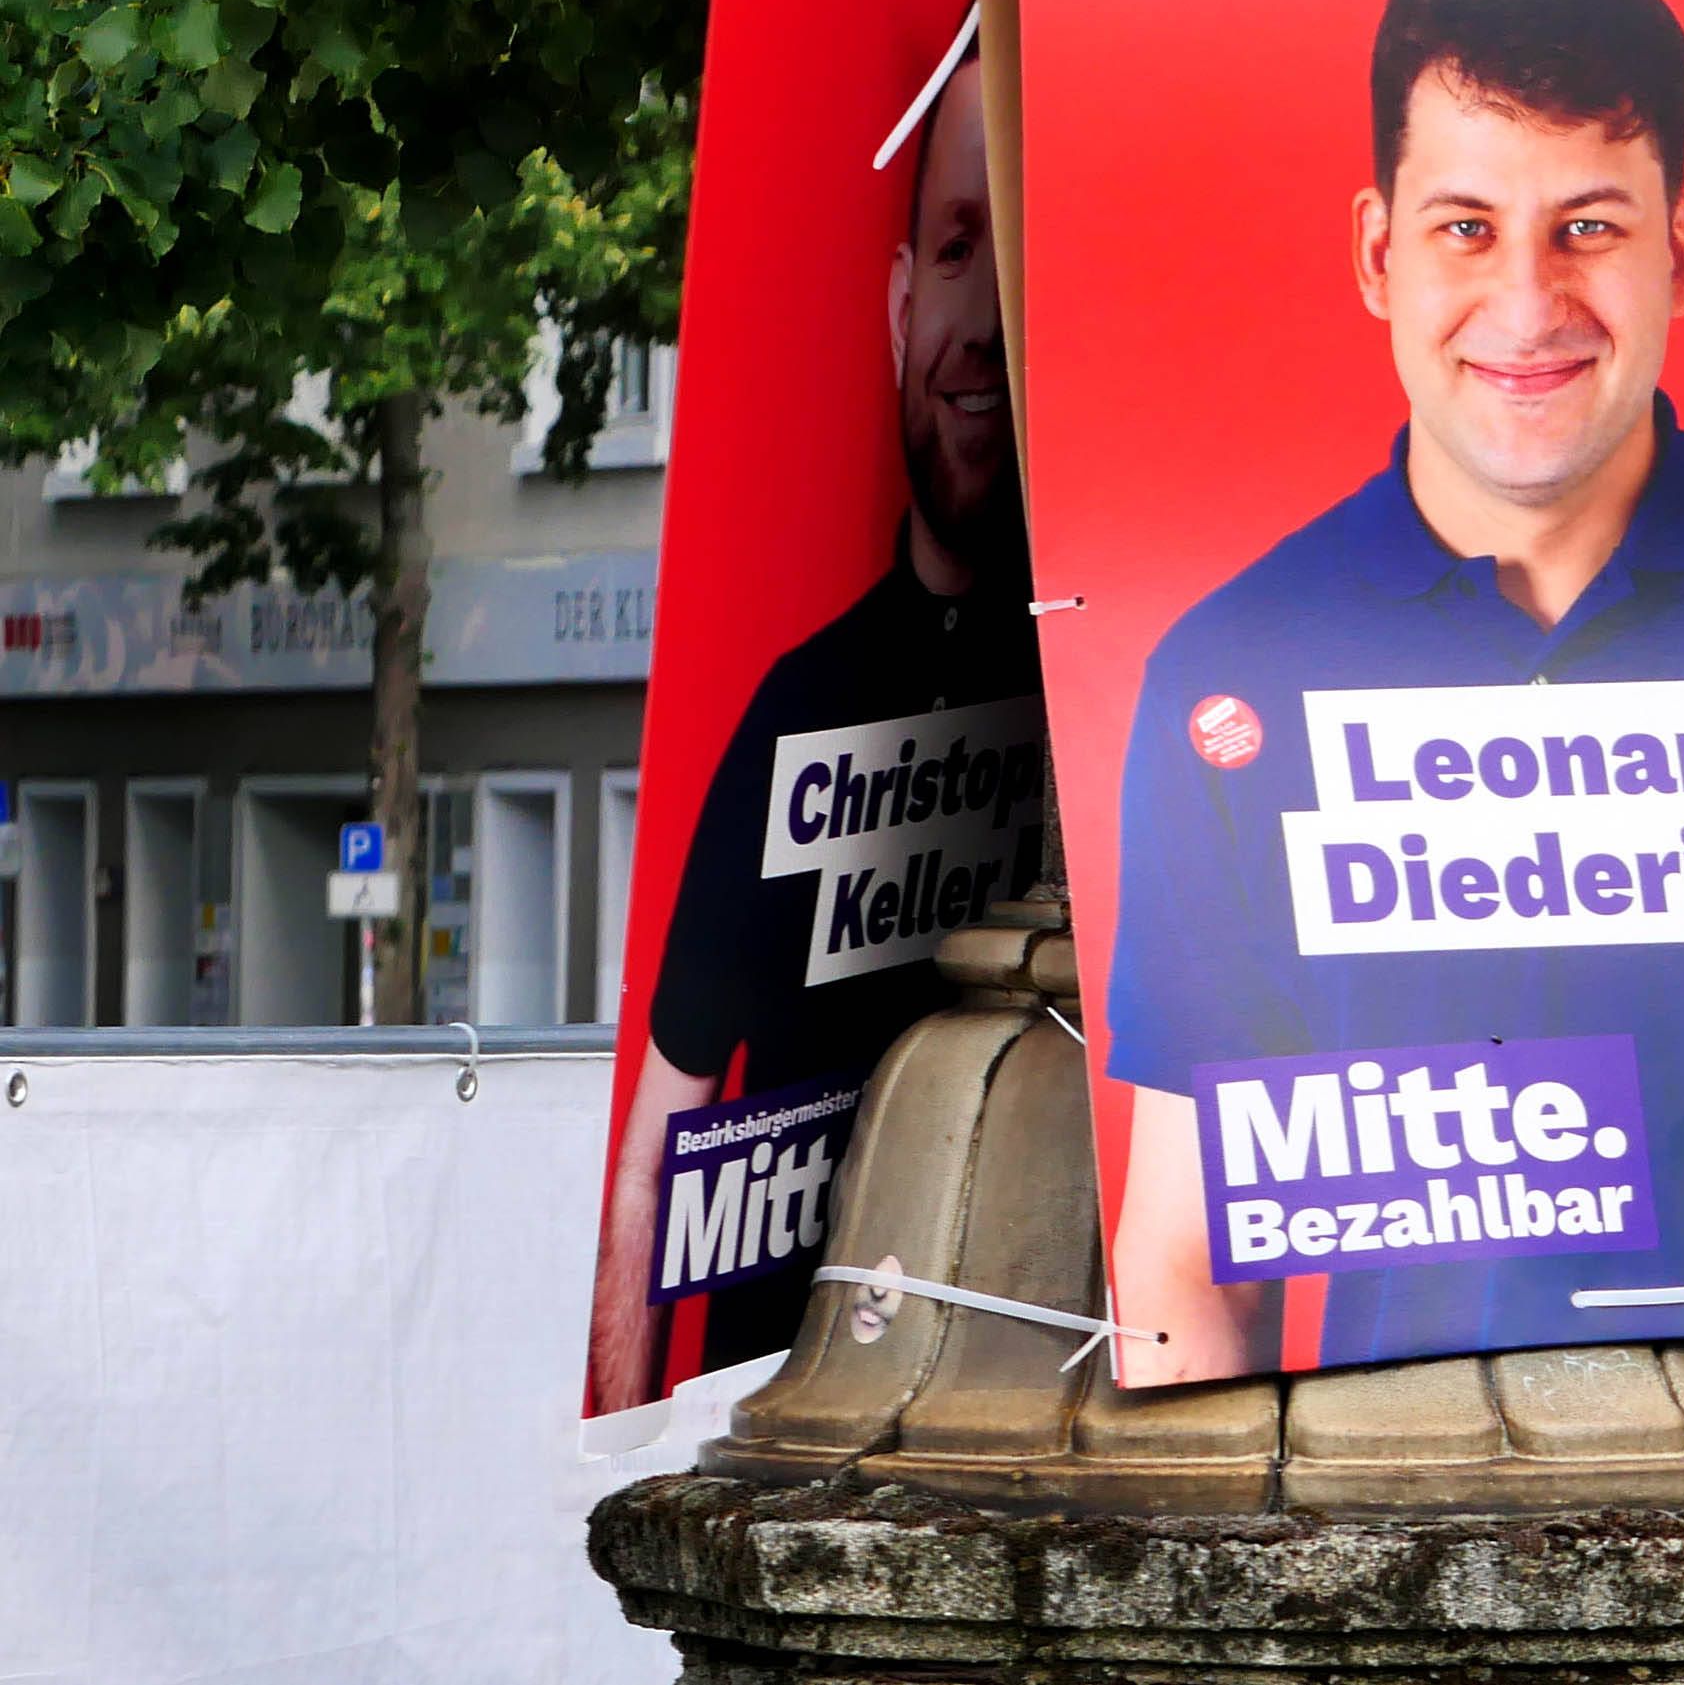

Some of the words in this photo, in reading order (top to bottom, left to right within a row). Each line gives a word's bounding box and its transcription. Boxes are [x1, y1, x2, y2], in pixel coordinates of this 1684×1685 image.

[789, 736, 1042, 845] Christop
[348, 830, 371, 866] P
[827, 849, 1002, 953] Keller
[676, 1090, 859, 1155] Bezirksbürgermeister
[1215, 1058, 1628, 1188] Mitte.
[661, 1134, 836, 1289] Mitt
[1225, 1171, 1635, 1264] Bezahlbar
